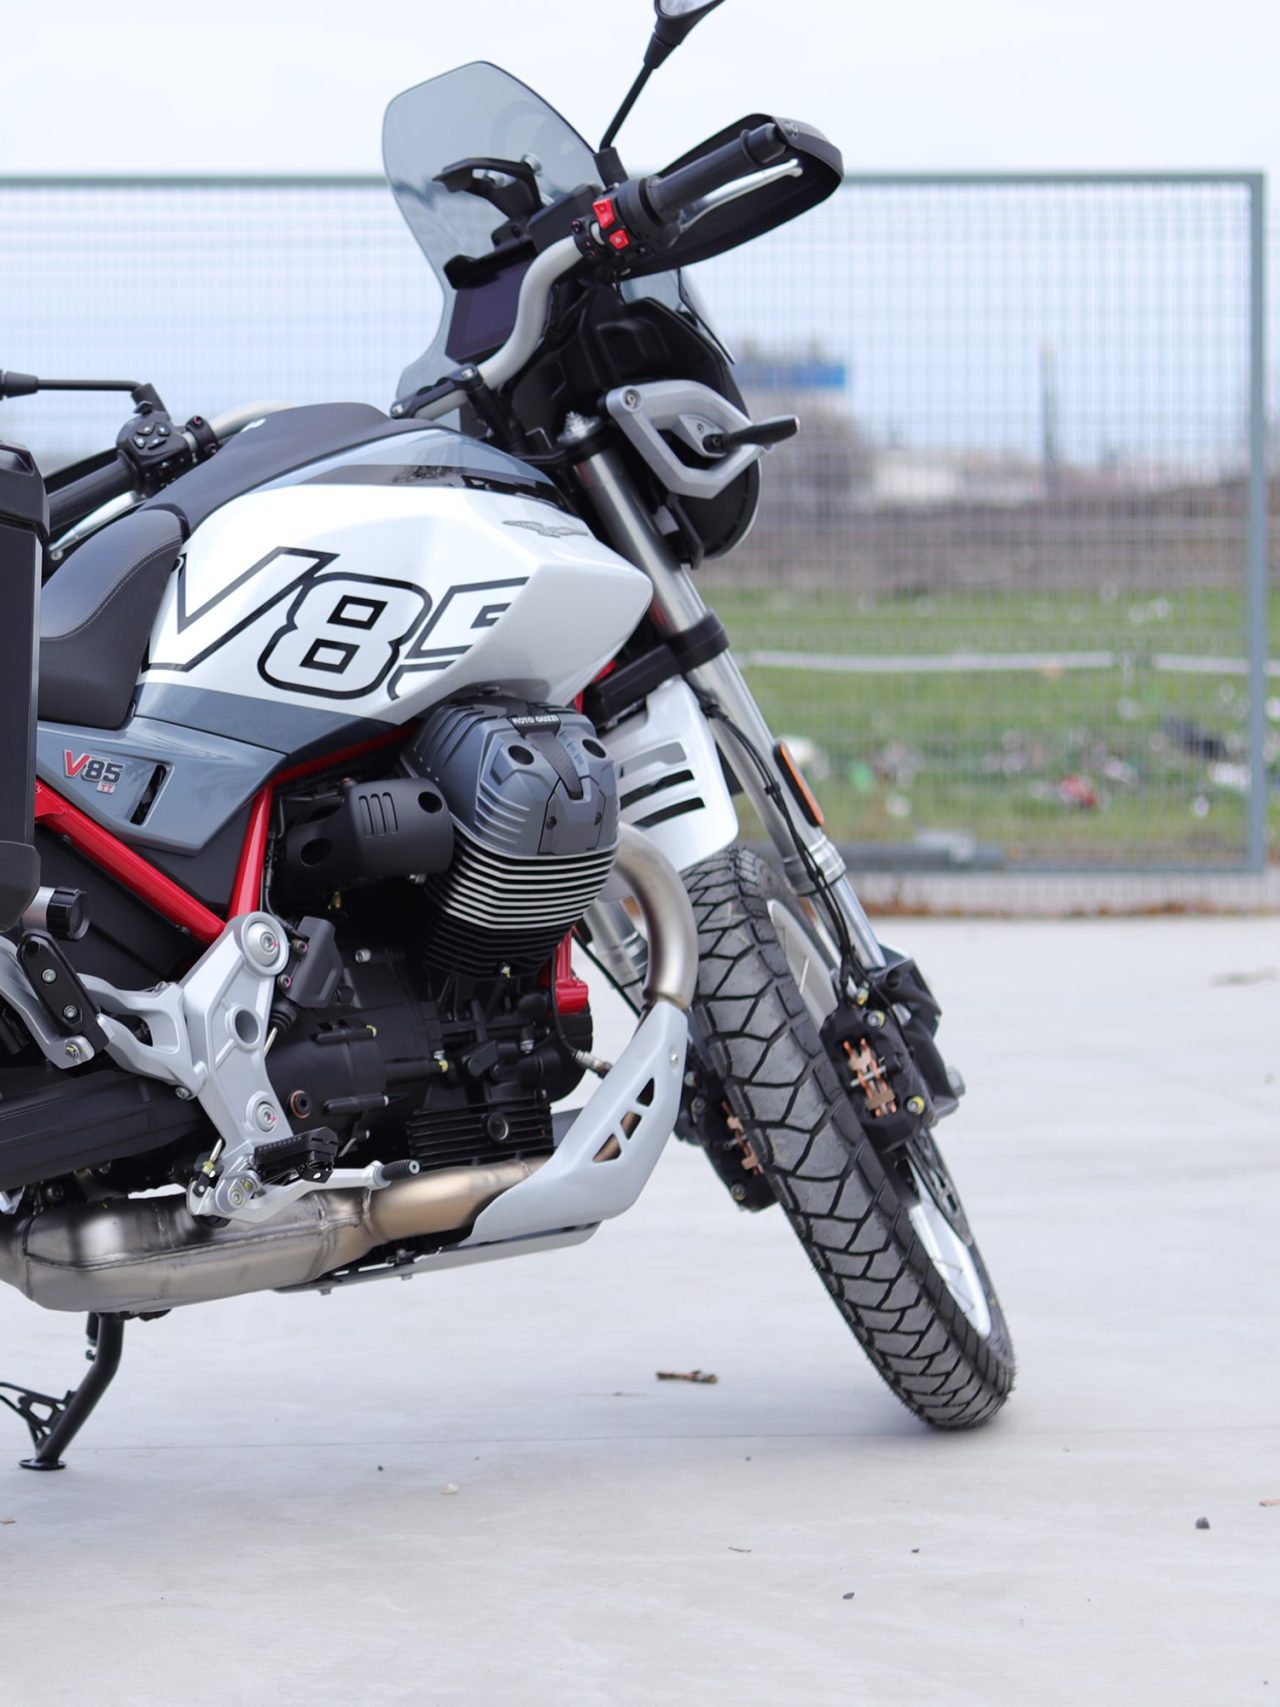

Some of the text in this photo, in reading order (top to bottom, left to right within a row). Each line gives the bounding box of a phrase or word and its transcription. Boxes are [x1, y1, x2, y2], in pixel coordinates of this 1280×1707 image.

[511, 714, 559, 725] MOTO GUZZI
[63, 749, 125, 784] V85
